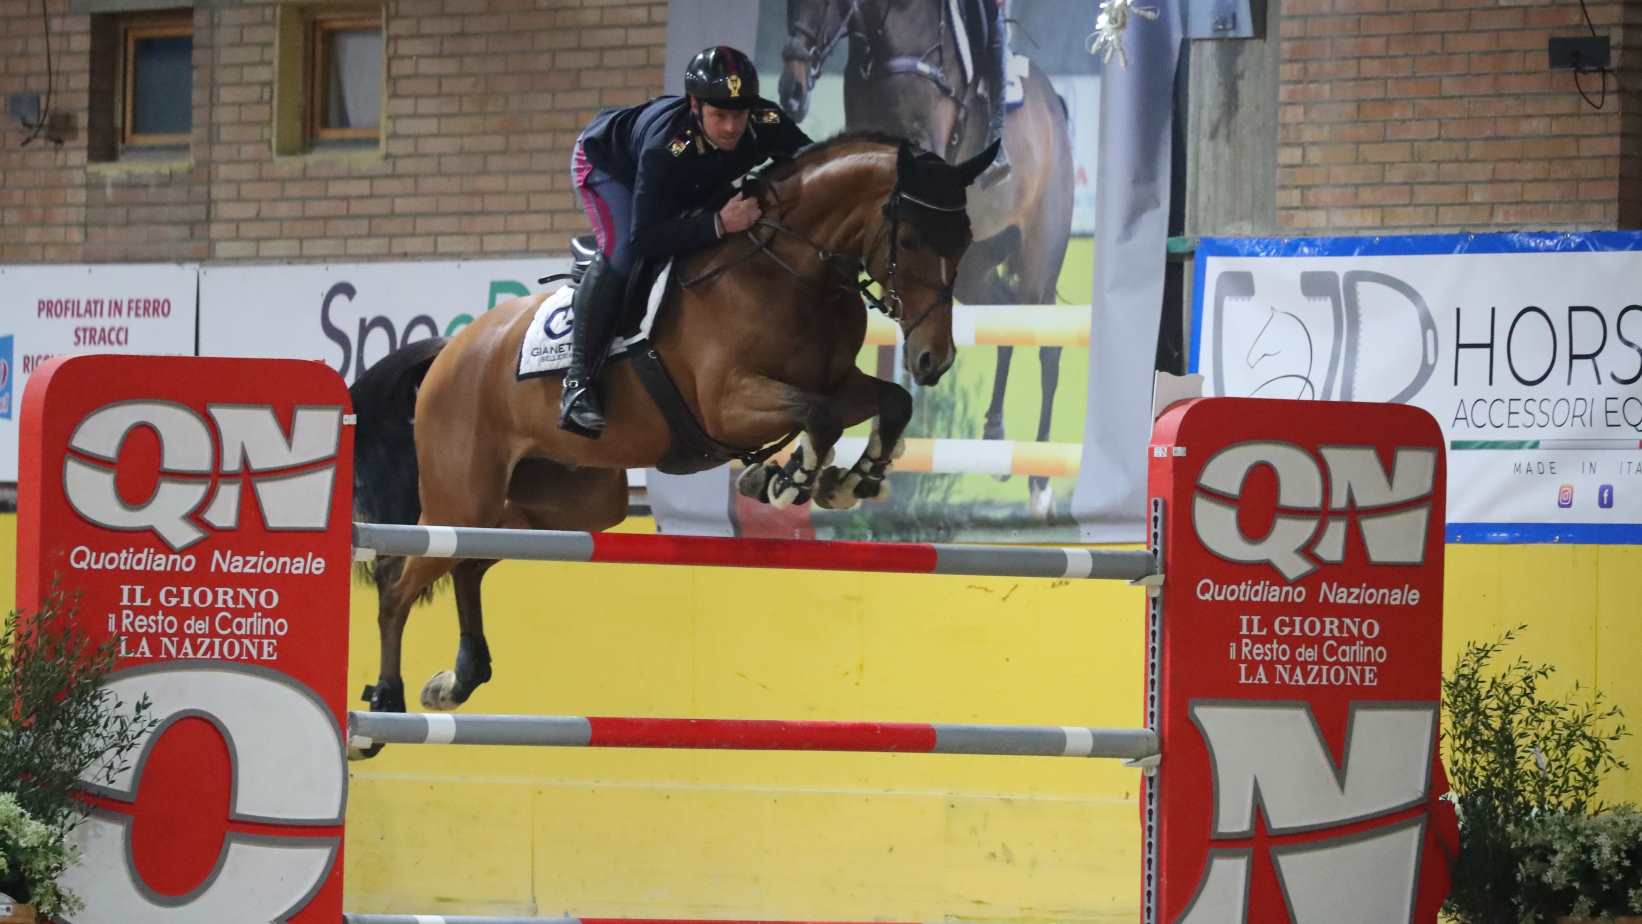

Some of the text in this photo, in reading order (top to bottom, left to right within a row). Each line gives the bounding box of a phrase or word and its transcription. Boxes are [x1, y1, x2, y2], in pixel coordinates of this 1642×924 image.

[37, 298, 171, 318] PROFILATI IN FERRO
[73, 326, 129, 347] STRACCI
[1452, 396, 1642, 433] ACCESSORI EQ
[62, 397, 344, 550] QN
[1513, 461, 1557, 475] MADE
[1581, 461, 1598, 475] IN
[1191, 440, 1439, 582] QN
[70, 546, 326, 575] Quotidiano Nazionale
[119, 585, 279, 609] IL GIORNO
[1196, 578, 1421, 606] Quotidiano Nazionale
[107, 609, 289, 637] il Resto del Carlino
[1239, 615, 1380, 639] IL GIORNO
[117, 635, 279, 661] LA NAZIONE
[1229, 638, 1388, 664] il Resto del Carlino
[1238, 663, 1378, 686] LA NAZIONE
